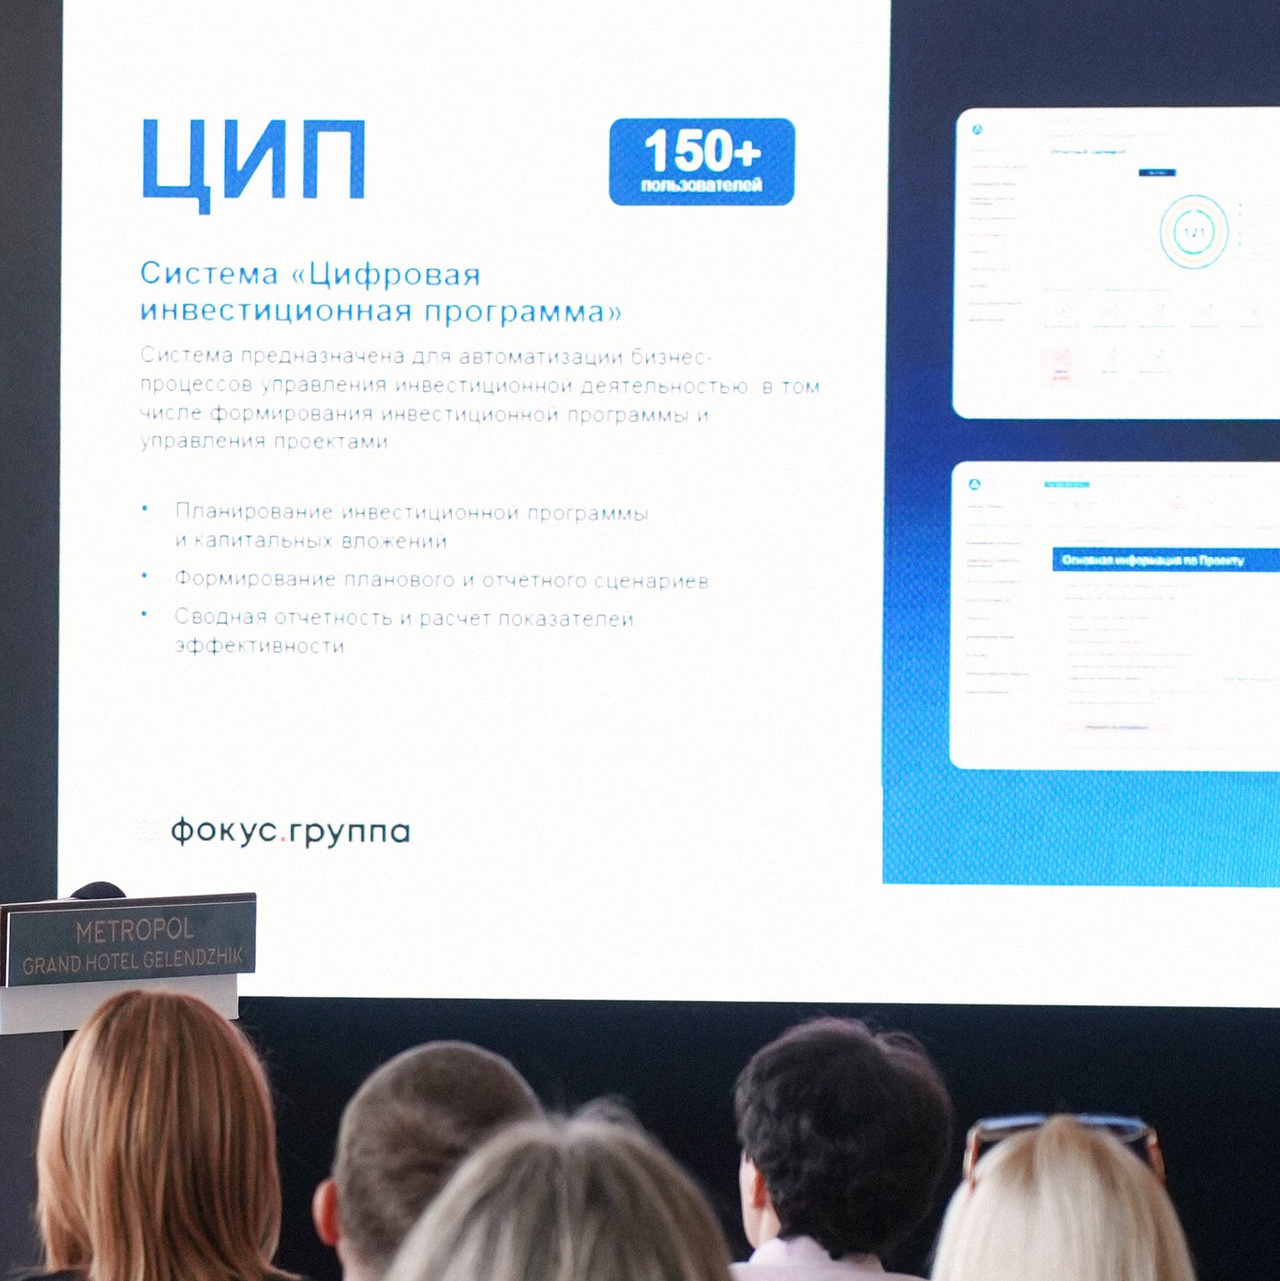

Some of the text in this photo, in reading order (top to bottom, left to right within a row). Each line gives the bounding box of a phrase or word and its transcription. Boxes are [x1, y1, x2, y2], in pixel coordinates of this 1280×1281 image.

[645, 128, 762, 173] 150+
[142, 118, 366, 216] ЦИП
[640, 176, 763, 193] пользователей
[140, 259, 481, 292] Система «Цифровая
[140, 301, 623, 329] инвестиционная программа»
[140, 344, 713, 368] Система предназначена для автоматизации бизнес-
[140, 376, 253, 397] процессов
[261, 376, 388, 398] управления
[394, 376, 574, 398] инвестиционной
[761, 379, 774, 396] в
[780, 379, 821, 396] том
[139, 403, 710, 428] числе формирования инвестиционной программы и
[140, 432, 267, 453] управления
[175, 500, 649, 526] Планирование инвестиционной программы
[175, 533, 188, 548] и
[193, 533, 333, 550] капитальных
[175, 567, 710, 592] Формирование планового и отчетного сценариев
[173, 605, 635, 630] Сводная отчетность и расчет показателей
[175, 636, 345, 658] эффективности
[170, 815, 412, 850] фокус.группа
[75, 915, 194, 945] METROPOL
[22, 946, 244, 976] GRAND HOTEL GELENDZHIK
